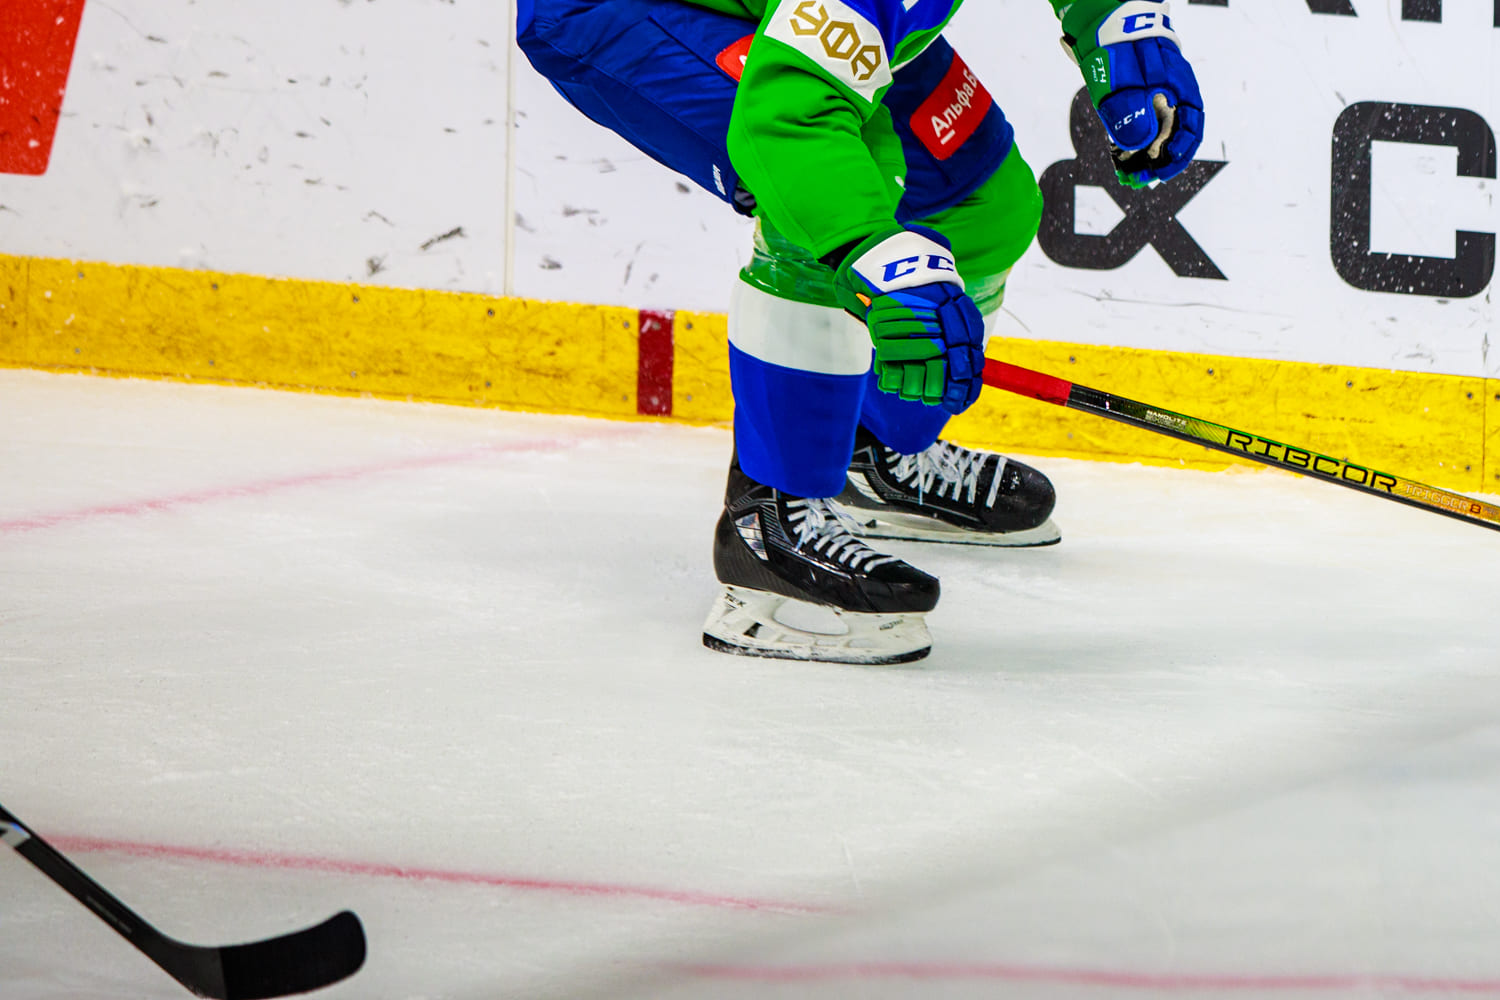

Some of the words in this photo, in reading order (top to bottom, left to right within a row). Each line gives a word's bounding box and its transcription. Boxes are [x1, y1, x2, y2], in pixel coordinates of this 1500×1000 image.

[1114, 107, 1146, 130] CCM
[1225, 430, 1398, 493] RIBCOR
[1404, 483, 1469, 512] TRIGGER
